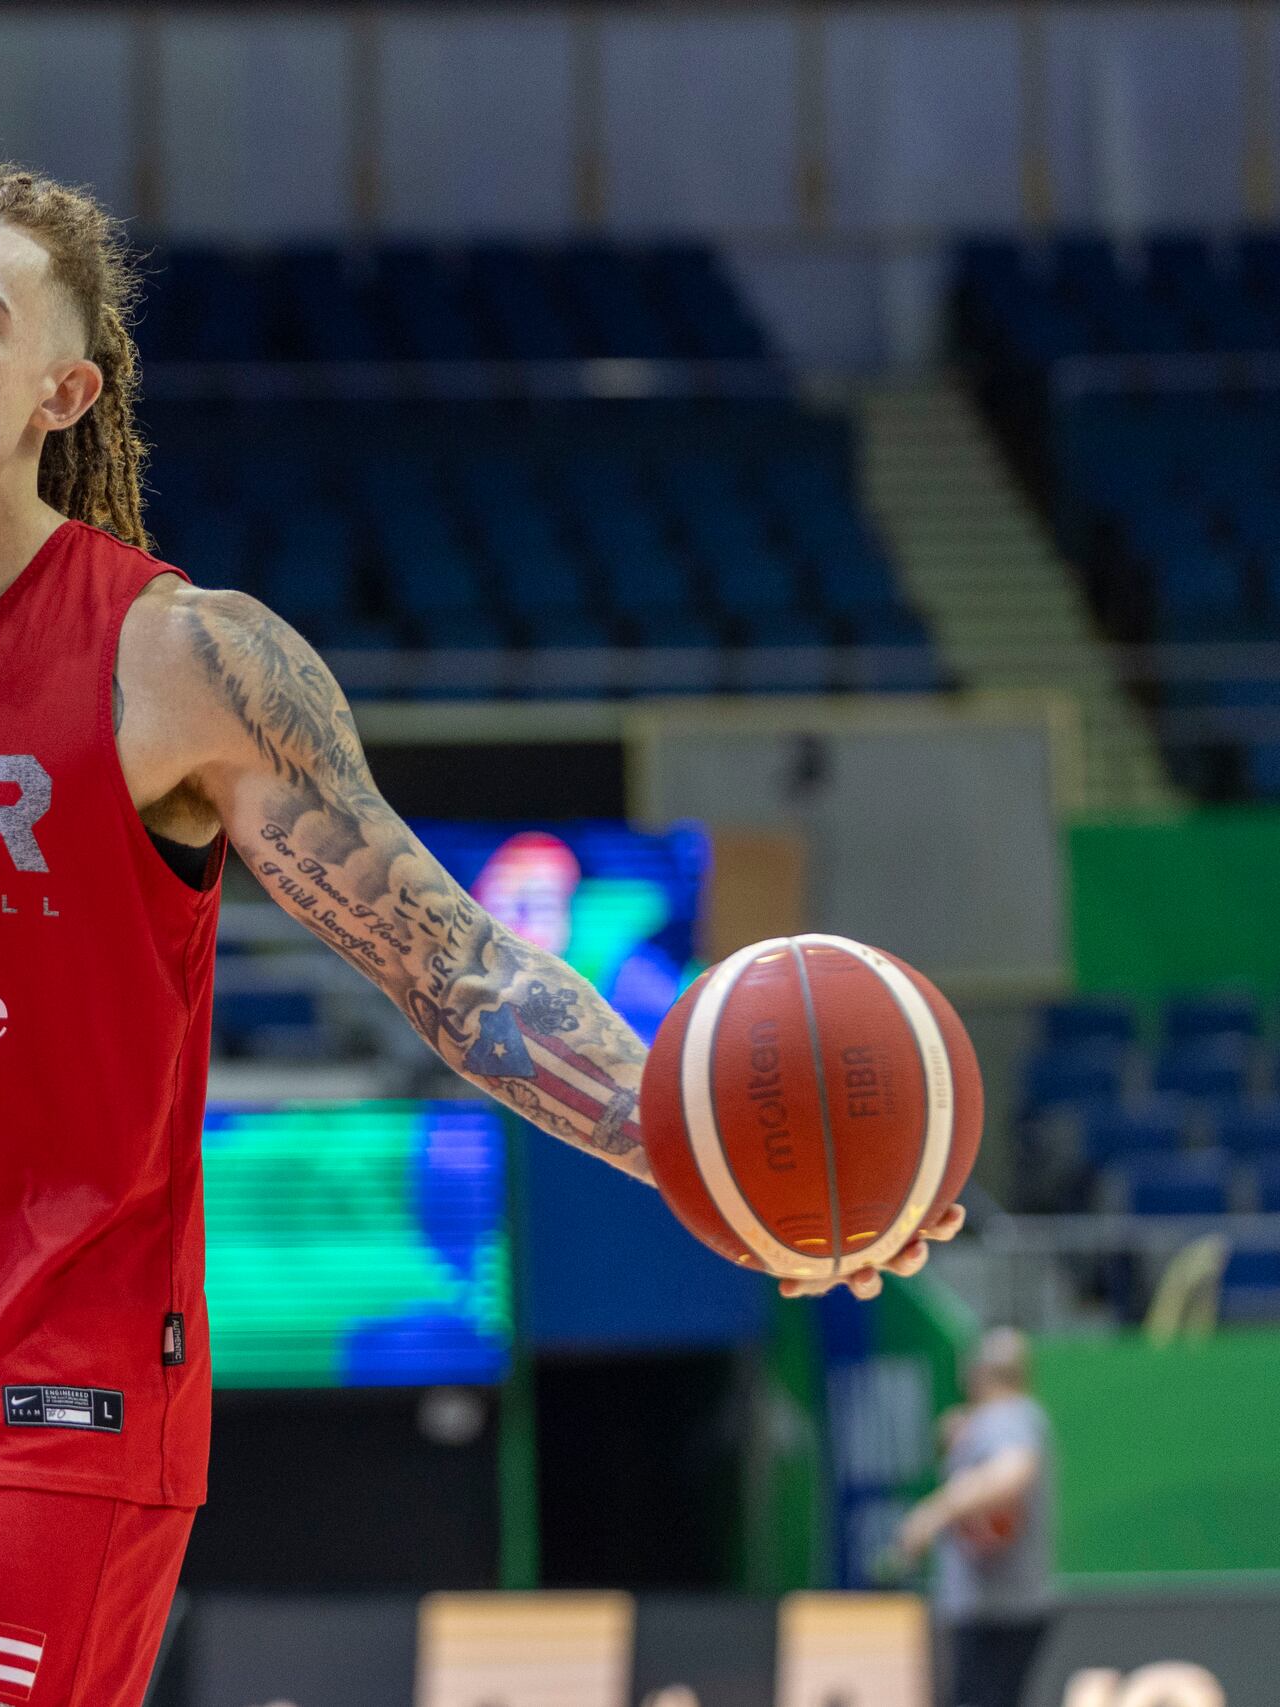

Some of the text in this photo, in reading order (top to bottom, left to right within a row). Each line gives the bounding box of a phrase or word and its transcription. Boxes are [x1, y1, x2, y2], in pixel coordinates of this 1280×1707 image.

[260, 823, 296, 858] For
[297, 857, 349, 907] Those
[363, 917, 412, 955] Love
[394, 886, 420, 921] IT
[278, 875, 319, 910] Will
[312, 909, 386, 966] Sacrifice
[417, 907, 445, 938] IS
[748, 1019, 797, 1173] molten
[842, 1046, 880, 1120] FIBA
[45, 1389, 89, 1398] ENGINEERED
[103, 1401, 113, 1419] L
[11, 1408, 41, 1416] TEAM
